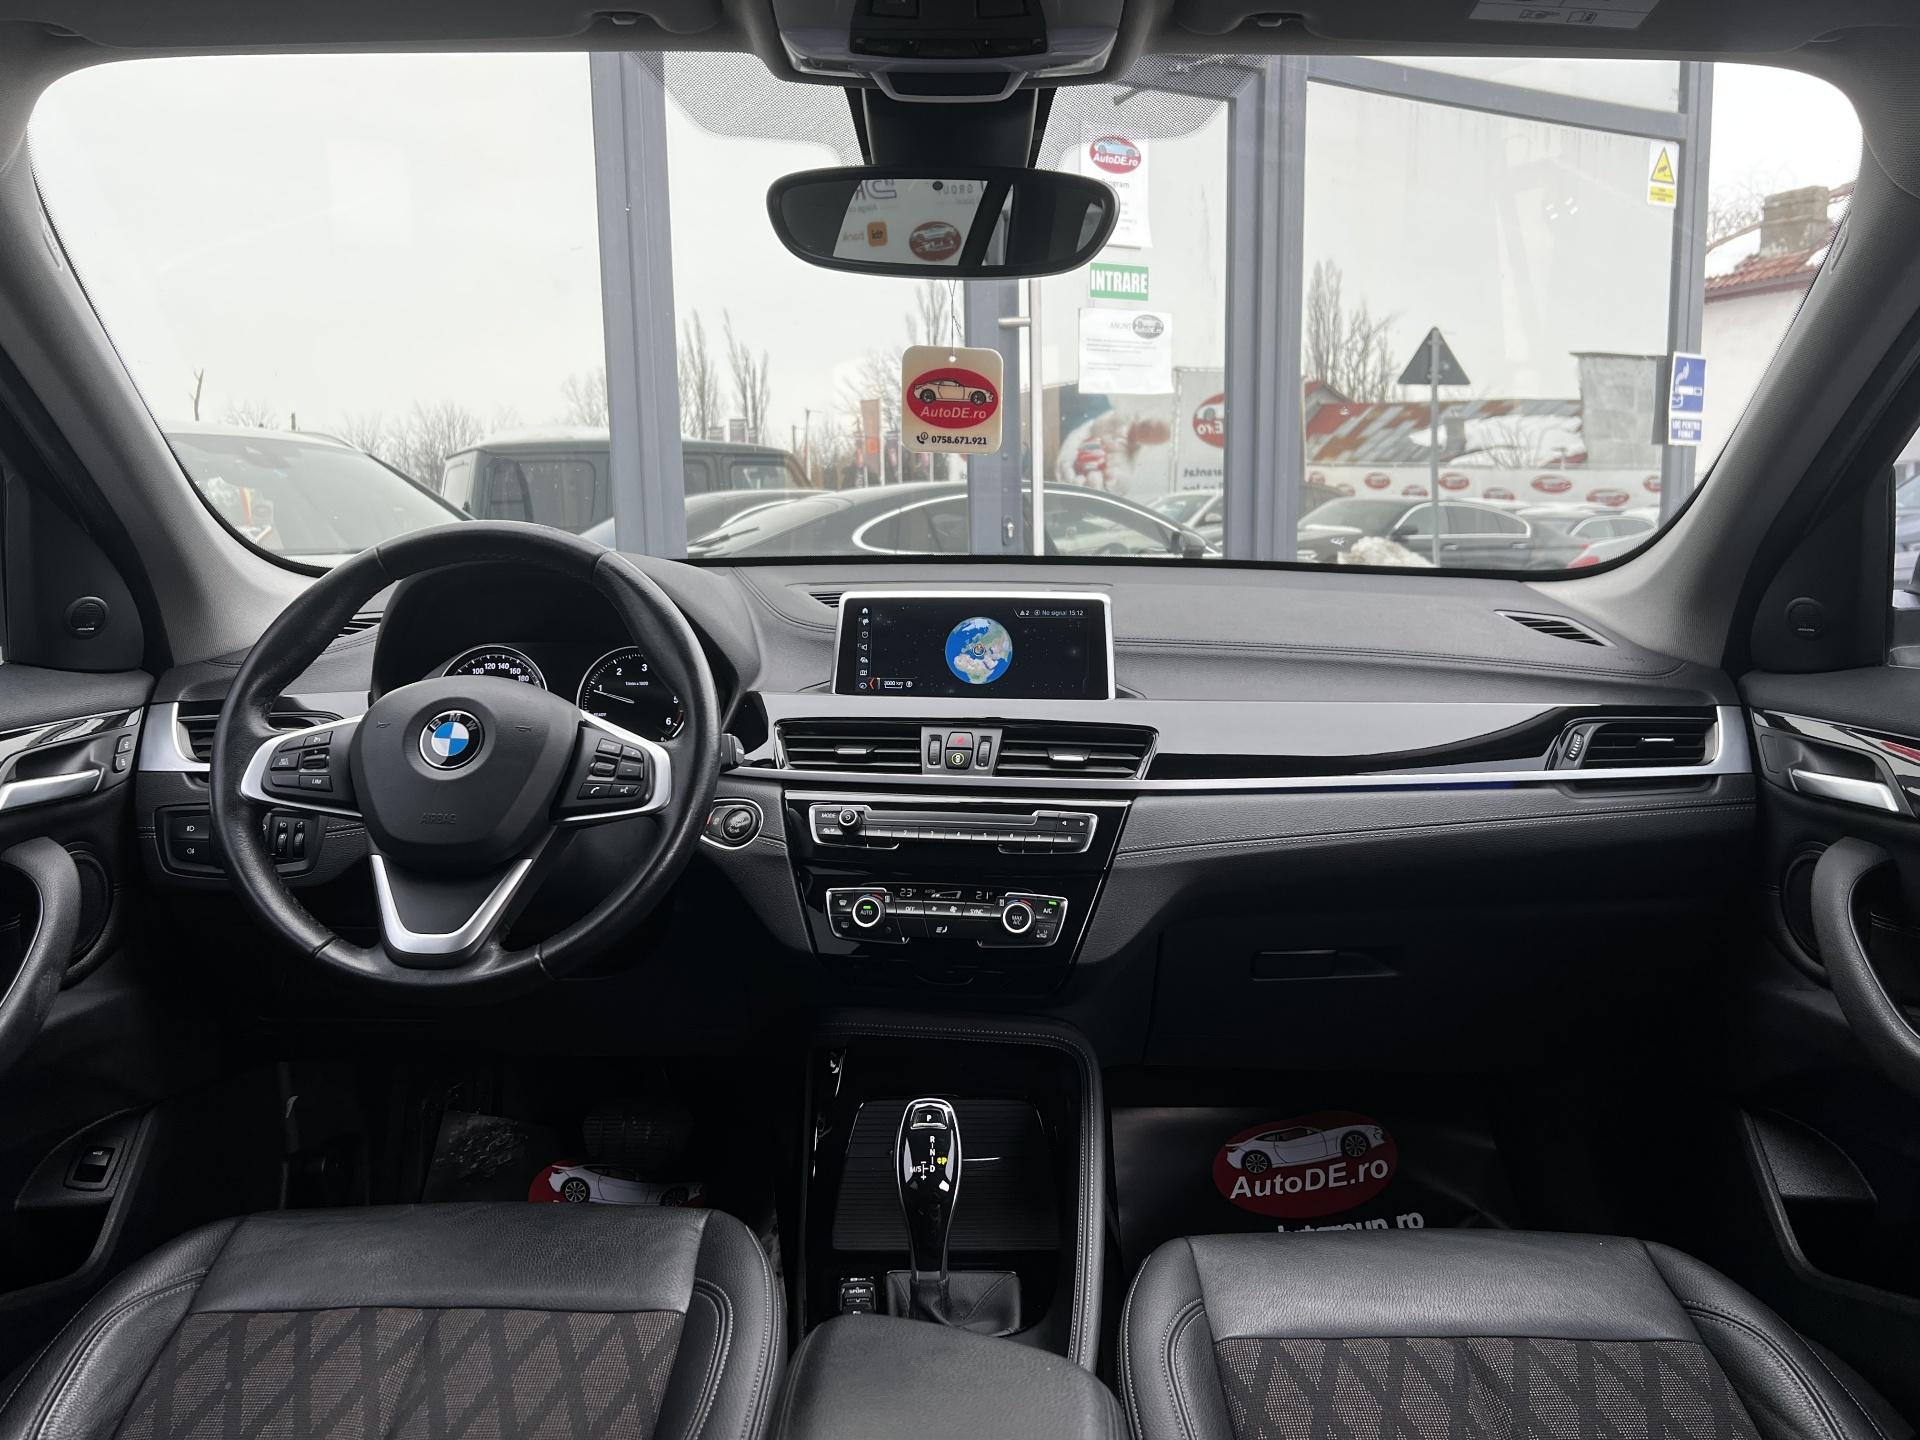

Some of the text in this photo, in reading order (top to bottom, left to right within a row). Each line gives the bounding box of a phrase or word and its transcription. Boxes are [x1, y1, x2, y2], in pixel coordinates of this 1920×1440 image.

[1093, 152, 1139, 167] AutoDE.ro
[1091, 269, 1147, 294] INTRARE
[920, 406, 987, 419] AutoDE.ro
[931, 435, 987, 445] 0758.671.921
[616, 668, 622, 676] 2
[641, 664, 648, 672] 3
[429, 712, 478, 731] BMW
[665, 717, 672, 725] 6
[926, 1114, 932, 1122] P
[929, 1135, 936, 1143] R
[929, 1148, 936, 1156] N
[929, 1164, 936, 1173] D
[1229, 1158, 1389, 1200] AutoDE.ro
